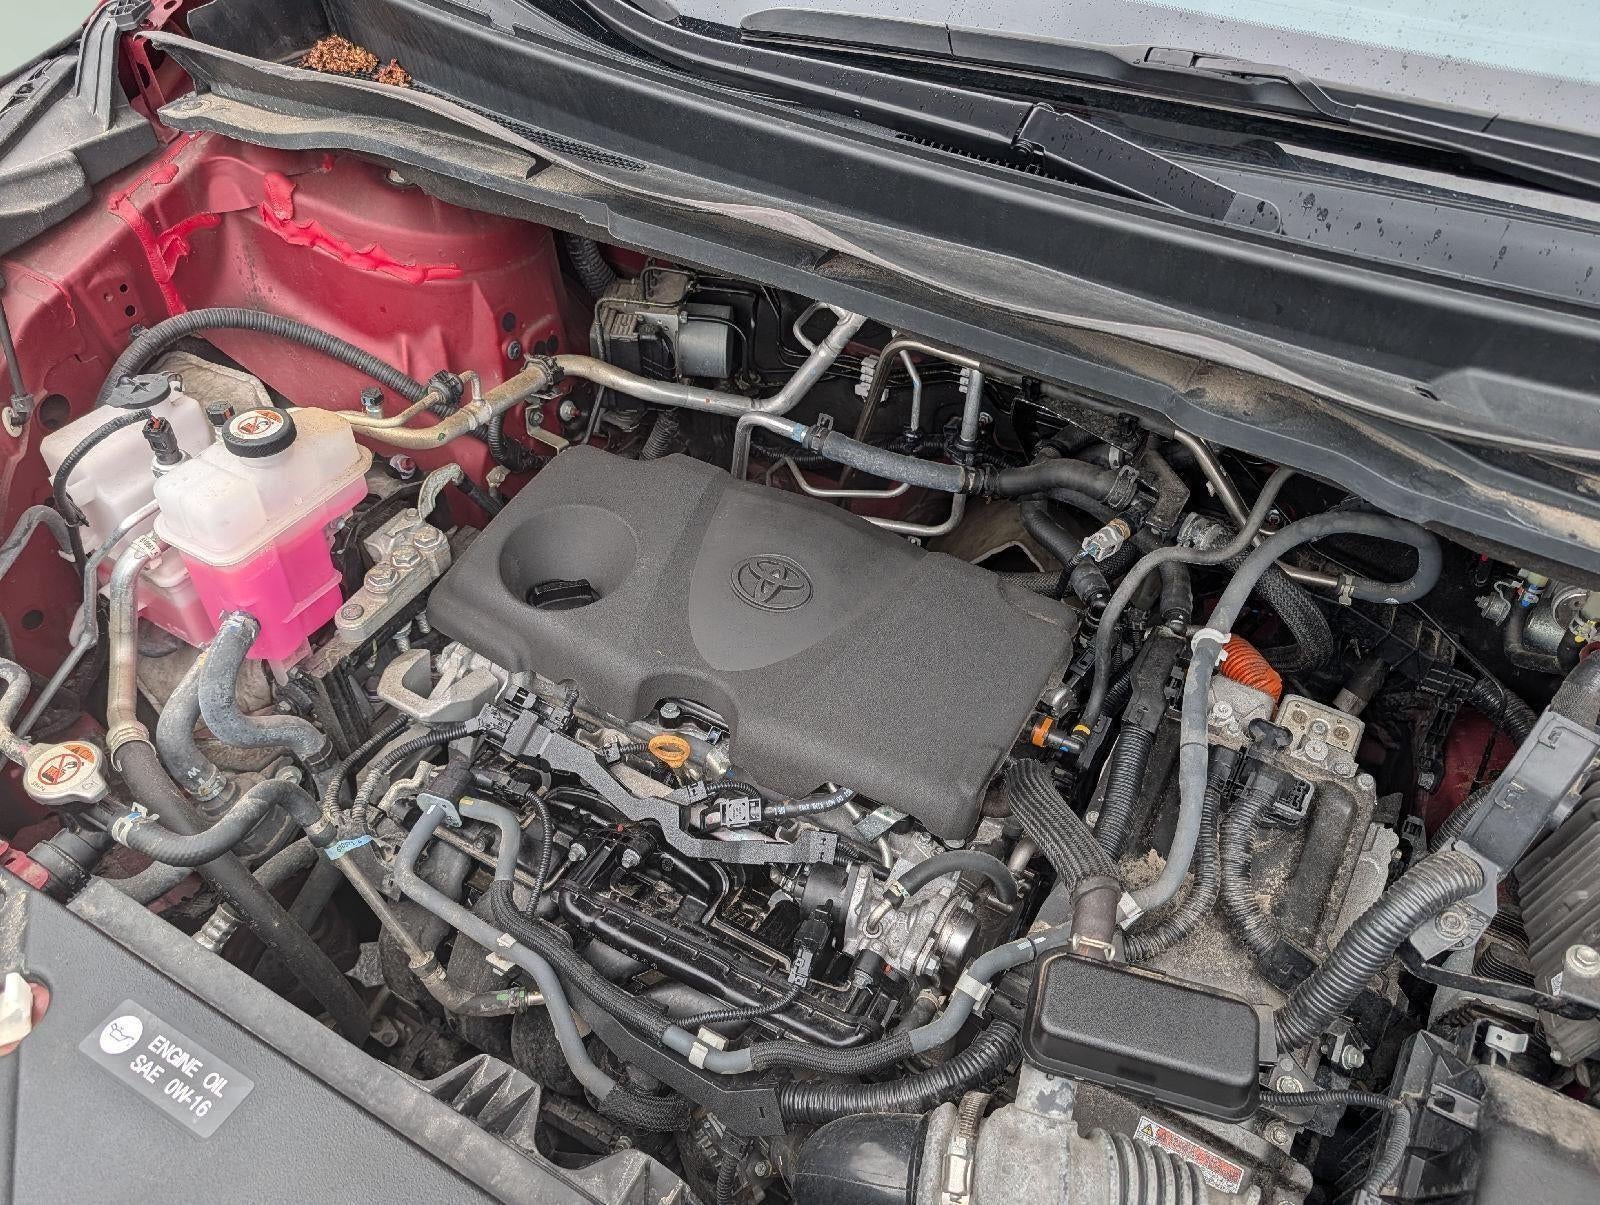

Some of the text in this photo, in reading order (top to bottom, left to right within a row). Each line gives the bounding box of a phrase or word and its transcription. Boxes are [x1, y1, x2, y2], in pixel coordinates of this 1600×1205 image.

[129, 1054, 213, 1118] SAE 0W-16
[148, 1034, 228, 1098] ENGINE OIL
